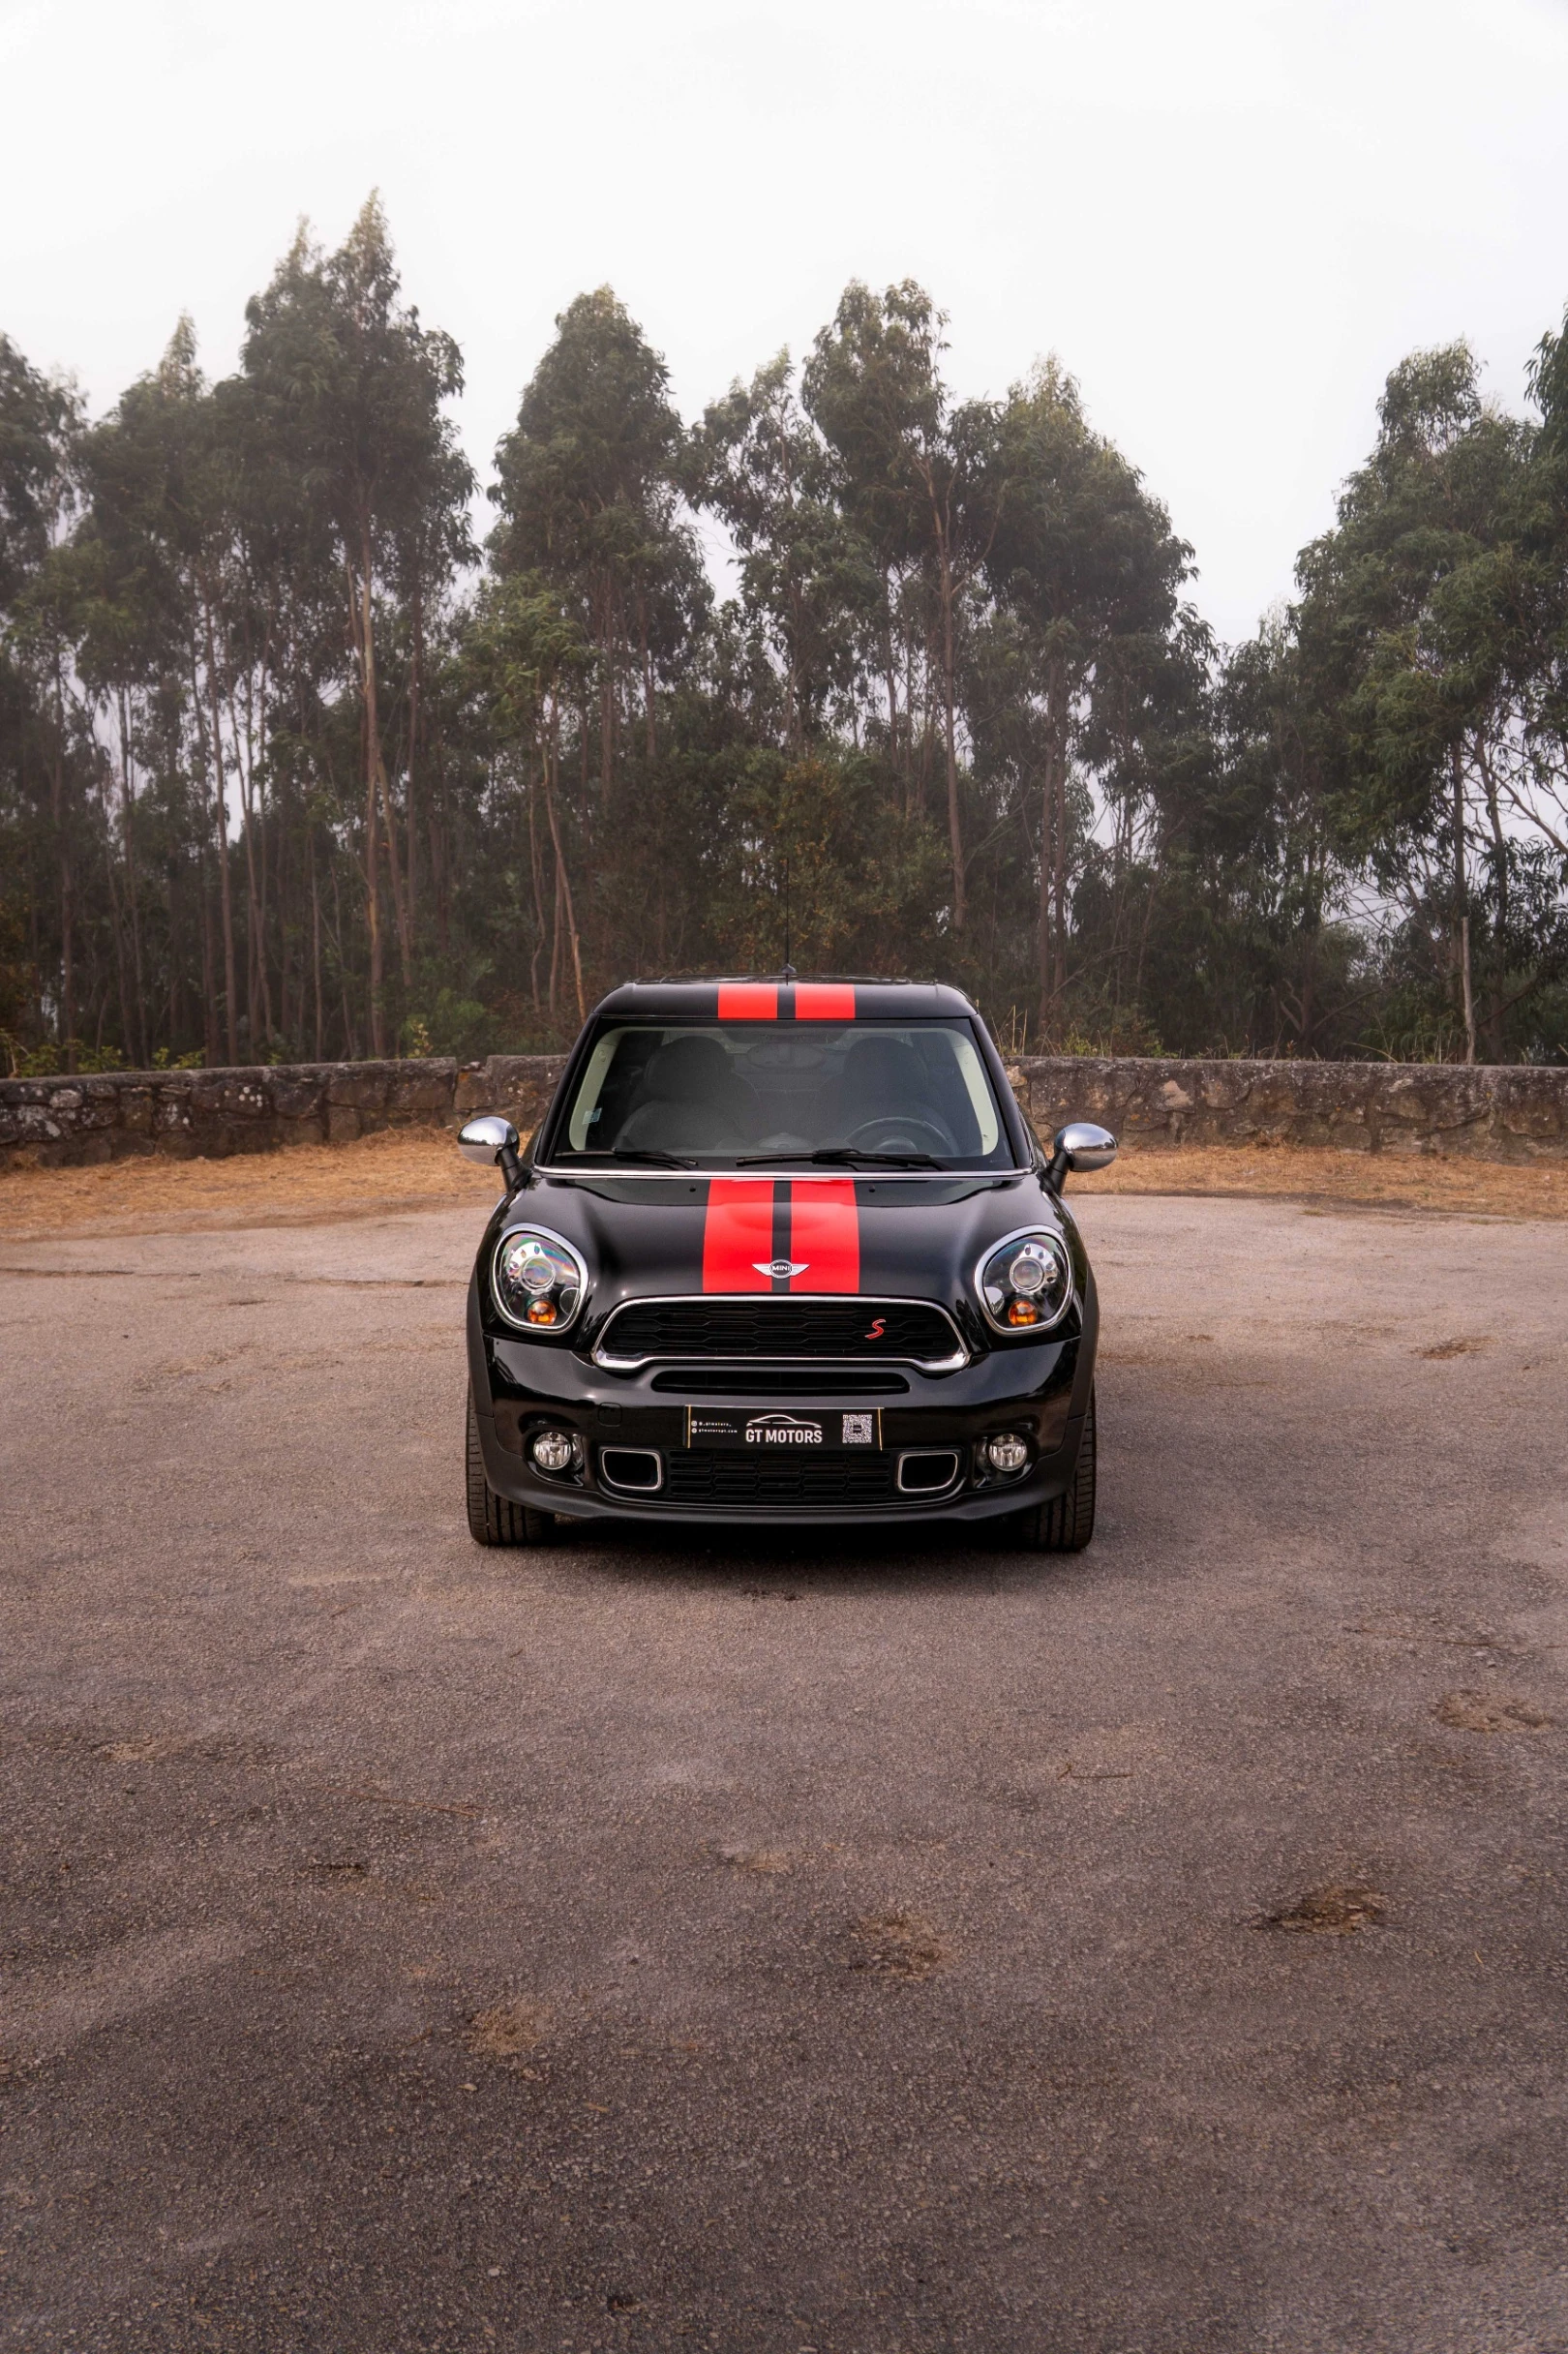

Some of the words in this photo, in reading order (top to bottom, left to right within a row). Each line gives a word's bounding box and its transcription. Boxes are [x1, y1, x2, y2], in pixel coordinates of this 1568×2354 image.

[864, 1318, 886, 1340] S
[745, 1430, 763, 1443] GT
[765, 1430, 823, 1444] MOTORS
